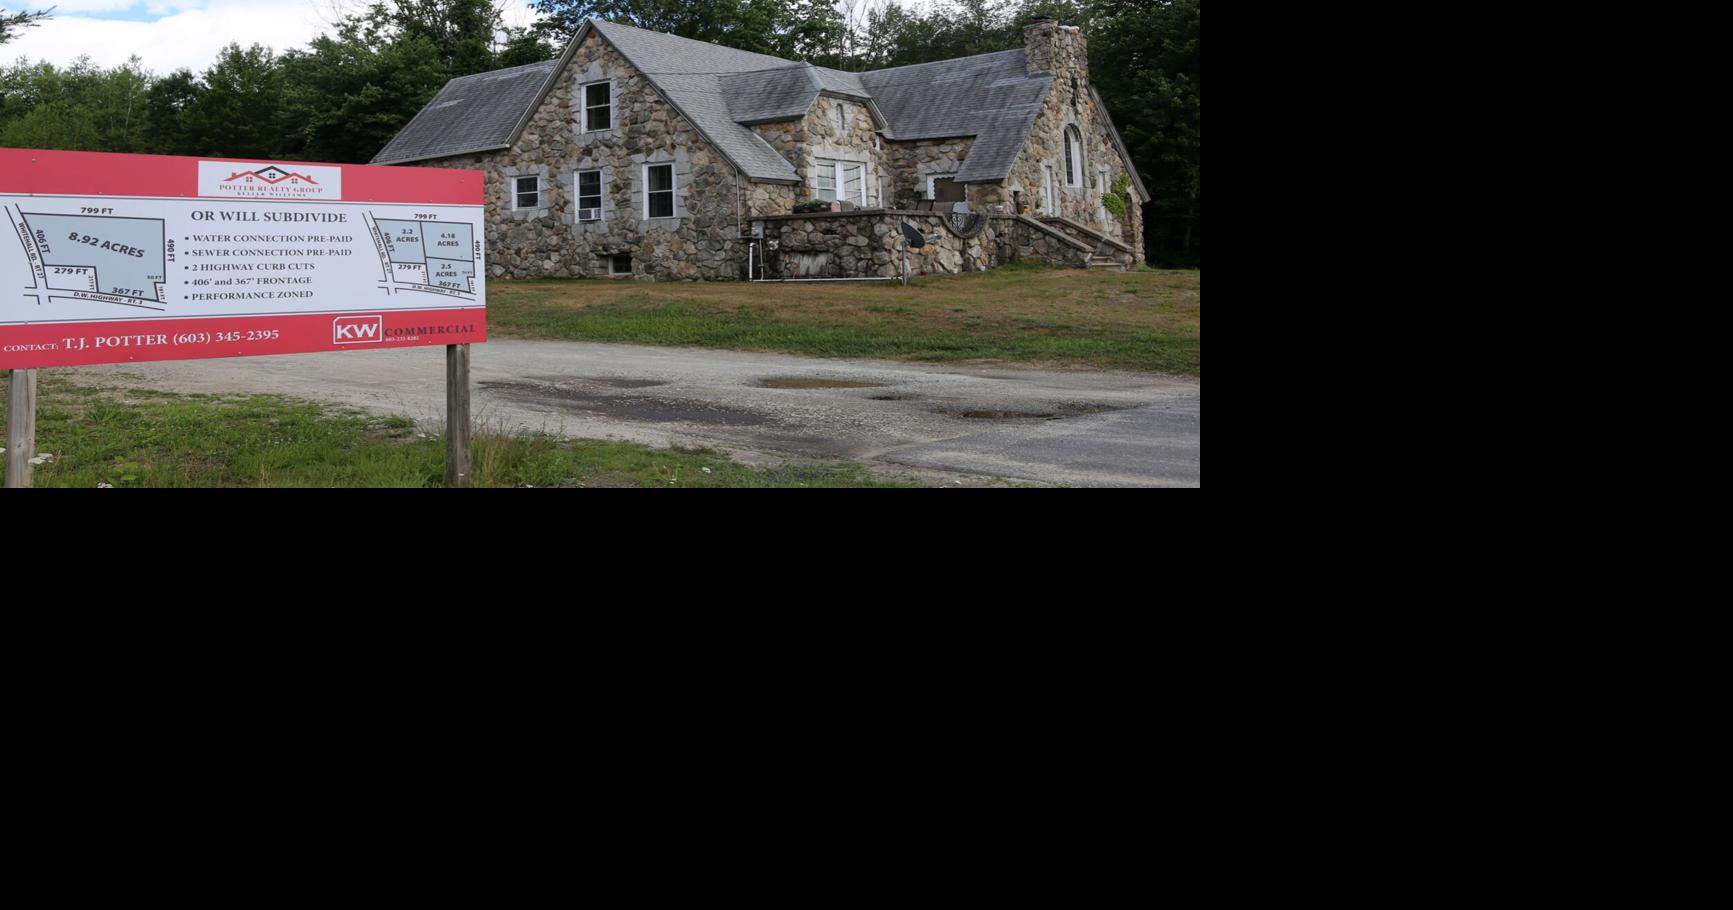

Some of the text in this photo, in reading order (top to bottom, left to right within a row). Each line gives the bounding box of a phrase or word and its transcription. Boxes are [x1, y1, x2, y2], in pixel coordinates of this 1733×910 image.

[101, 207, 114, 215] FT
[191, 210, 348, 223] OR WILL SUBDIVIDE
[18, 222, 34, 252] WHITEHALL
[36, 229, 51, 253] 406 FT
[192, 234, 353, 243] WATER CONNECTION PRE-PAID
[68, 232, 145, 258] 8.92 ACRES
[167, 253, 175, 262] FT
[192, 249, 230, 257] SEWER
[232, 249, 304, 257] CONNECTION
[200, 263, 255, 271] HIGHWAY
[287, 262, 316, 270] CUTS
[256, 277, 313, 285] FRONTAGE
[111, 287, 130, 295] 367
[192, 290, 314, 301] PERFORMANCE ZONED
[90, 294, 122, 302] HIGHWAY
[336, 323, 476, 339] KW COMMERCIAL
[62, 337, 90, 350] T.J.
[95, 334, 168, 348] POTTER
[173, 332, 211, 346] (603)
[215, 329, 280, 342] 345-2395
